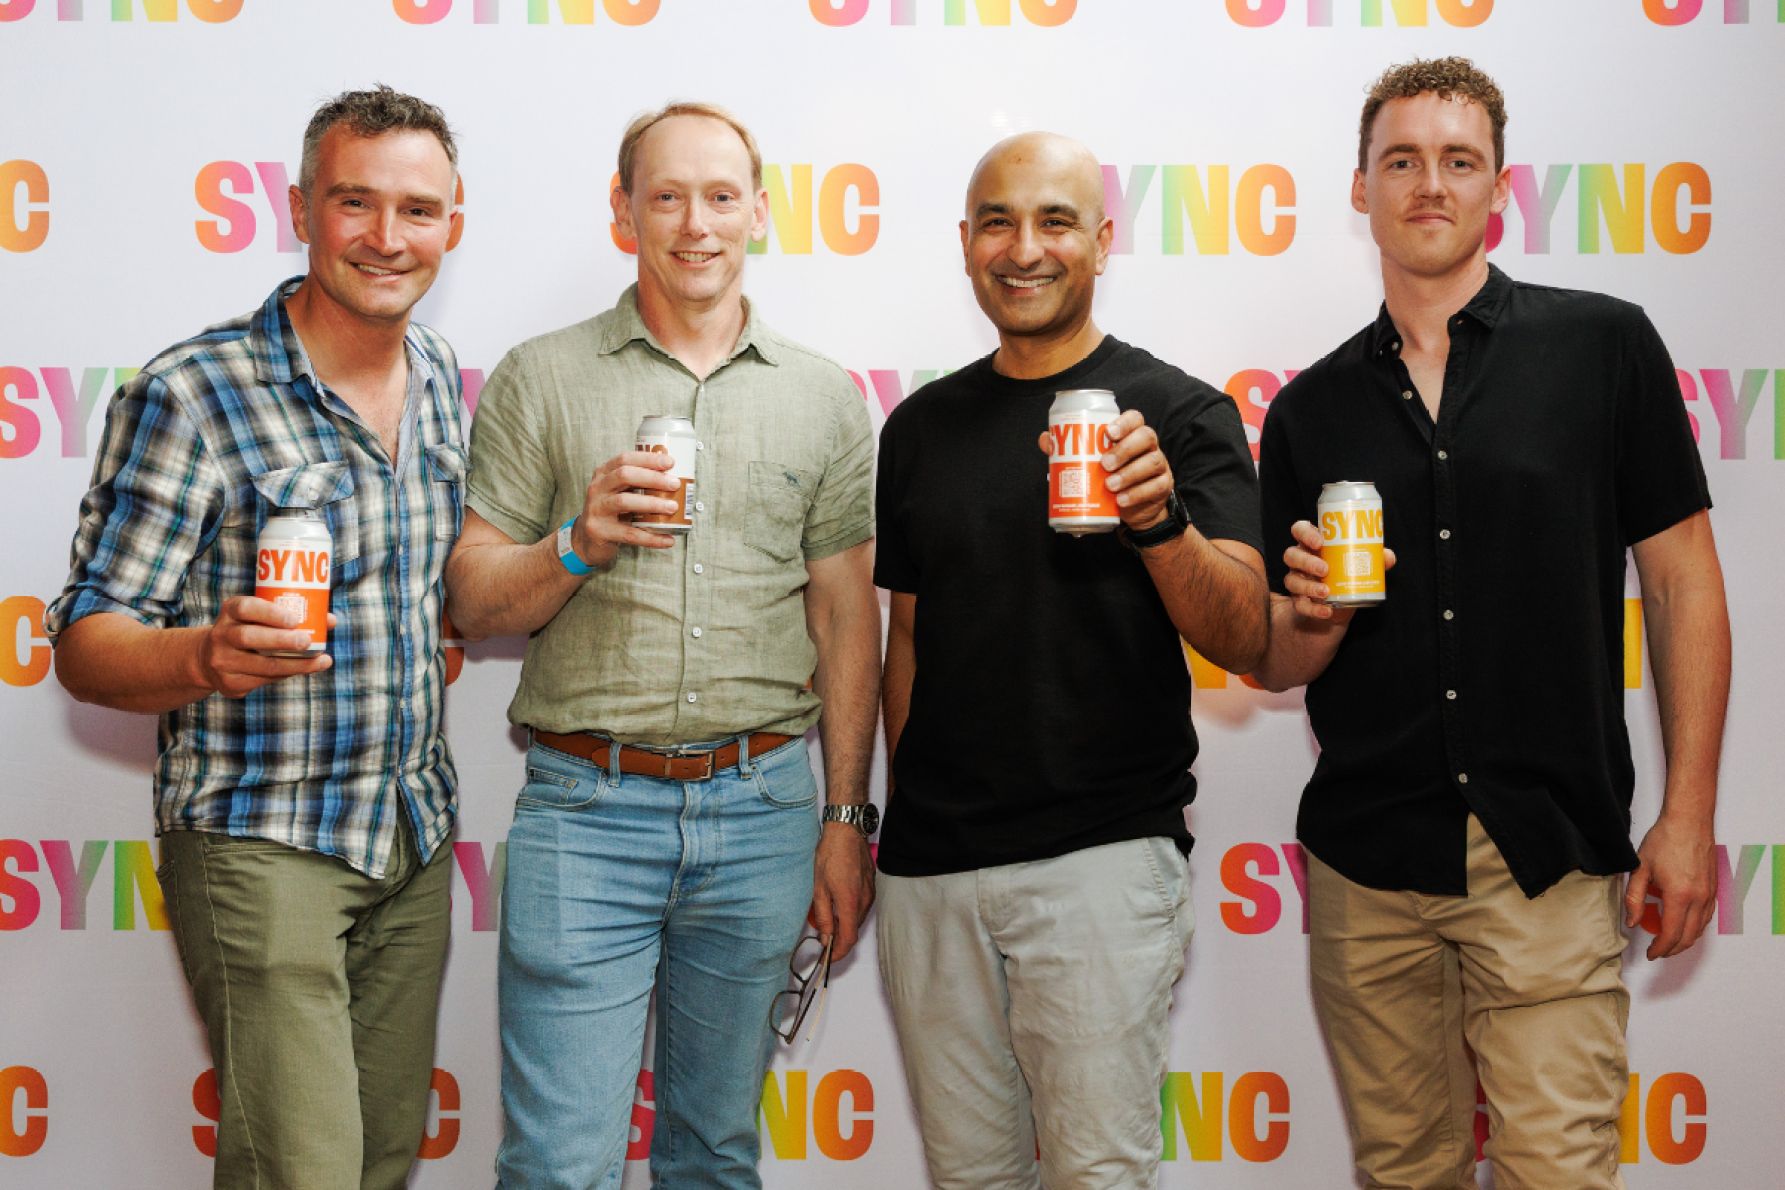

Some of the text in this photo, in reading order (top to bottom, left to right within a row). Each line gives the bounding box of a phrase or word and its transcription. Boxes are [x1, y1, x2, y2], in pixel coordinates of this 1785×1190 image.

[1100, 164, 1296, 256] YNC
[1487, 161, 1711, 255] YNC
[258, 548, 329, 584] SYNC
[0, 838, 171, 931] SYN
